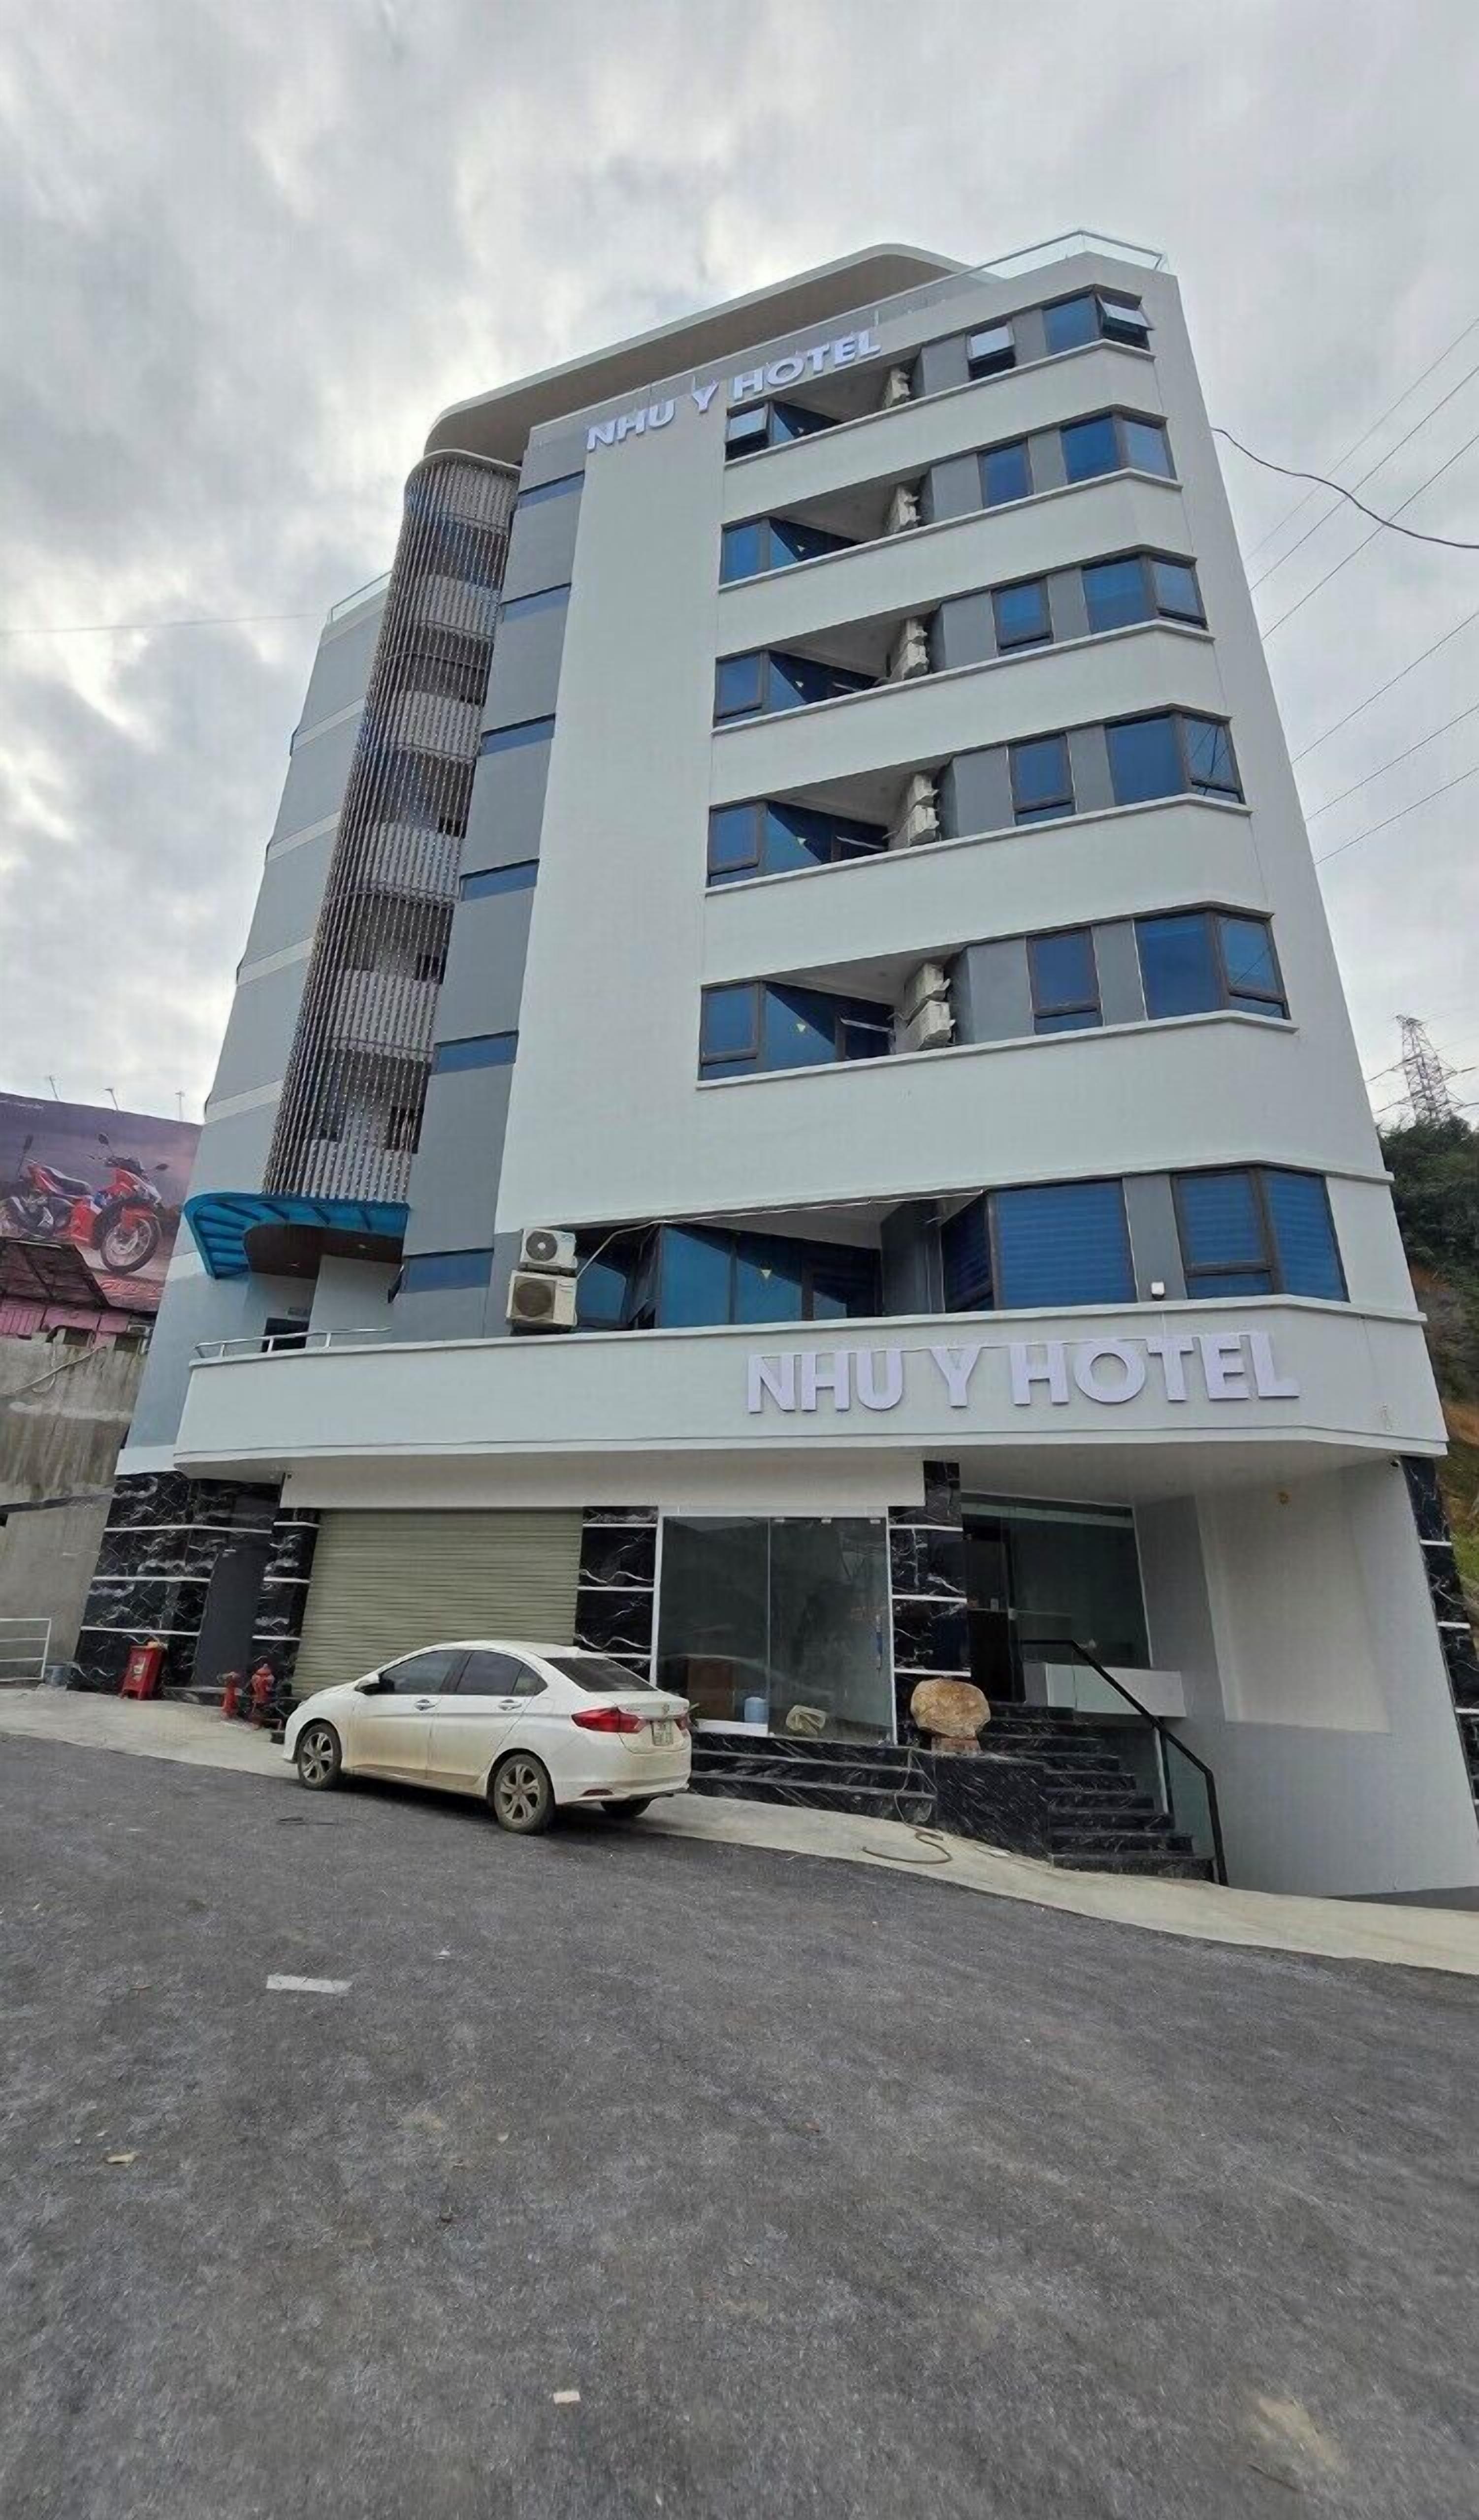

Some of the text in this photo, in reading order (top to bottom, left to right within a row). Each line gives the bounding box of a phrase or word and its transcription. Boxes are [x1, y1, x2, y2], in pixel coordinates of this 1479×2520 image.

[586, 330, 881, 451] NHU Y HOTEL
[749, 1332, 1299, 1413] NHU Y HOTEL
